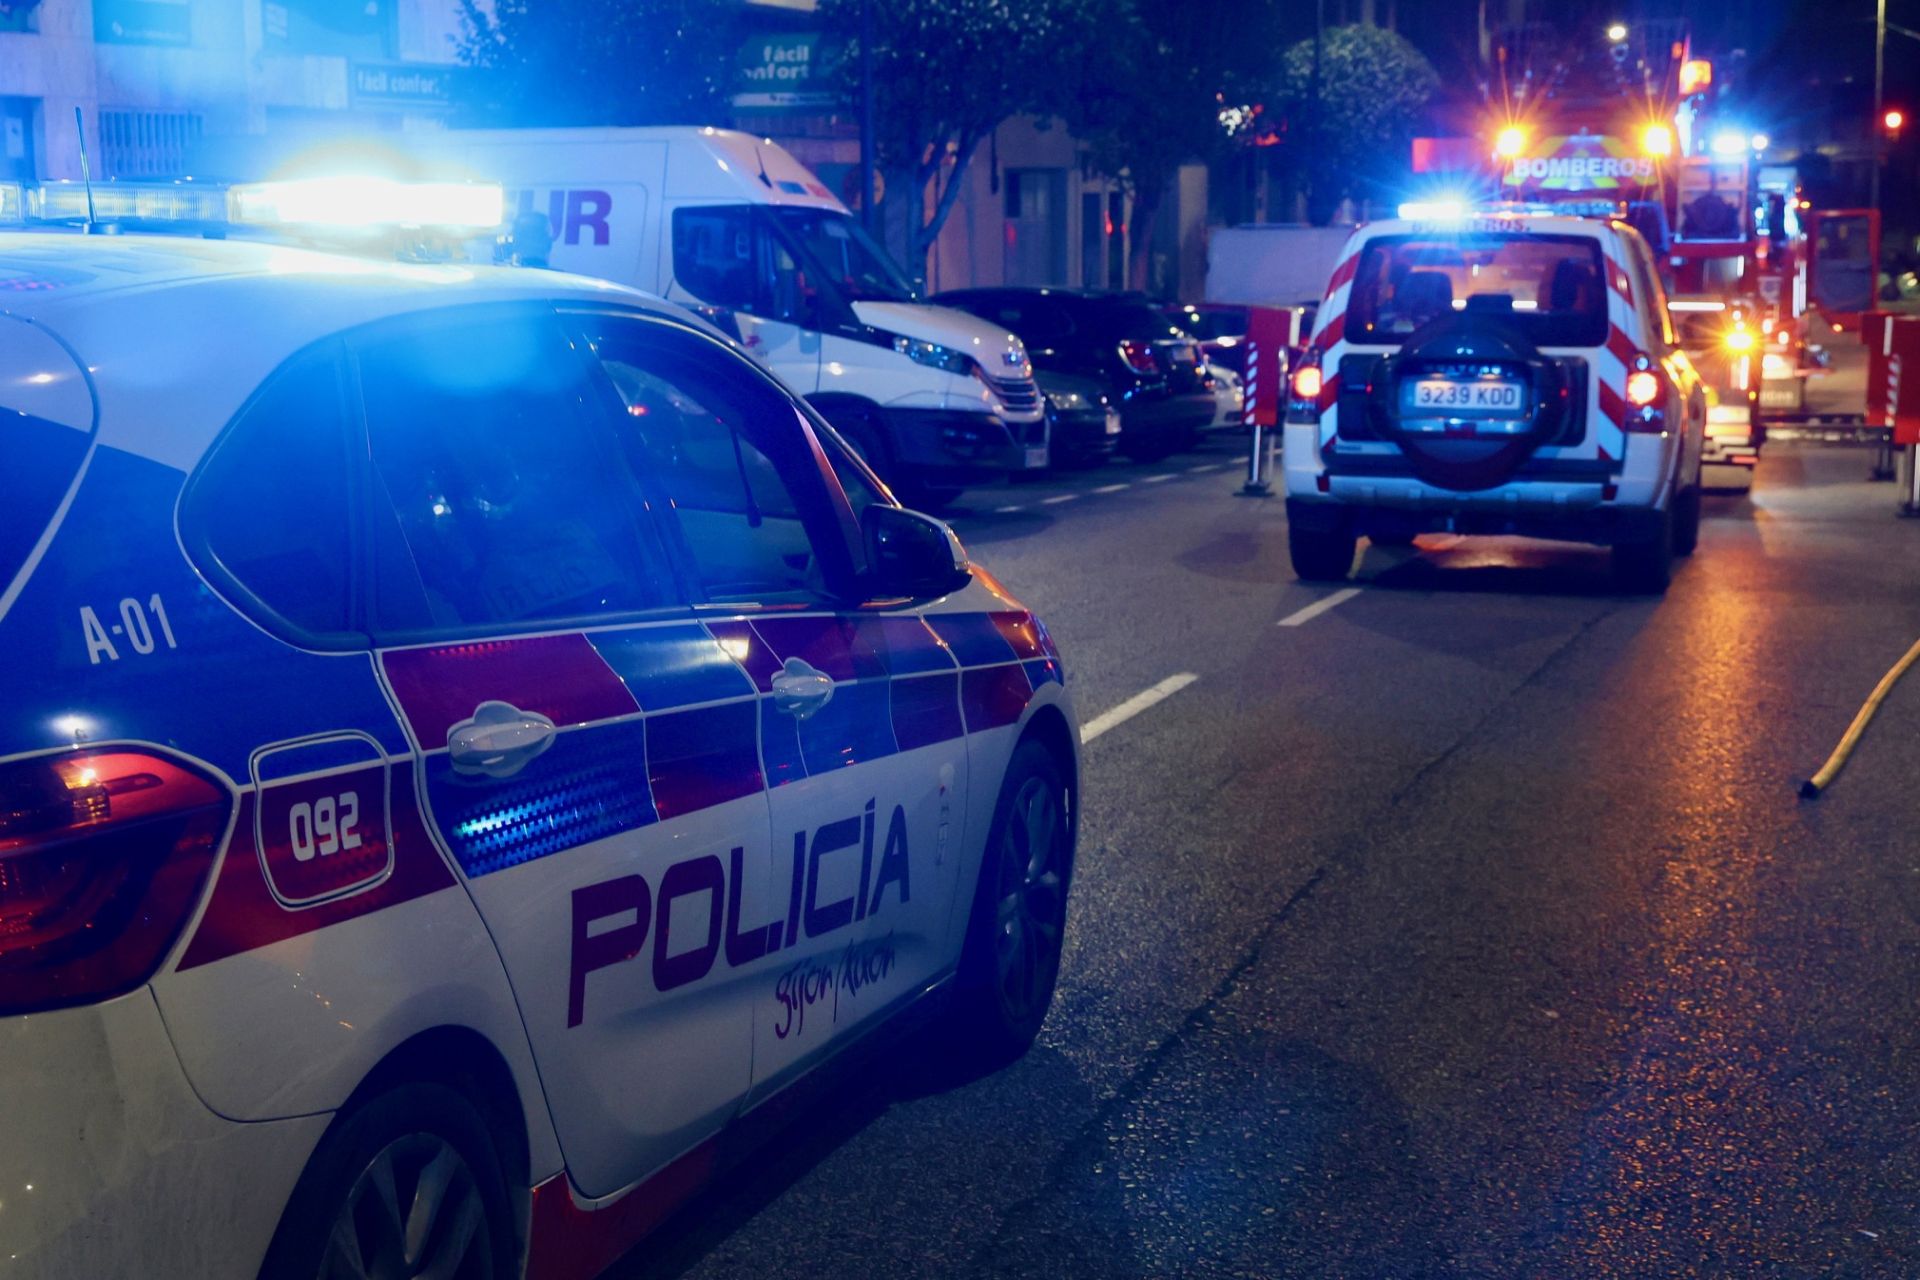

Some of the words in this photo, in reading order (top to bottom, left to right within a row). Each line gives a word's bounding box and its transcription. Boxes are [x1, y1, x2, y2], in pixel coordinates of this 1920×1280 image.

[763, 45, 808, 63] fácil
[1512, 157, 1653, 178] BOMBEROS
[1420, 386, 1471, 405] 3239
[79, 593, 177, 665] A-01
[289, 791, 362, 861] 092
[567, 796, 910, 1029] POLICÍA
